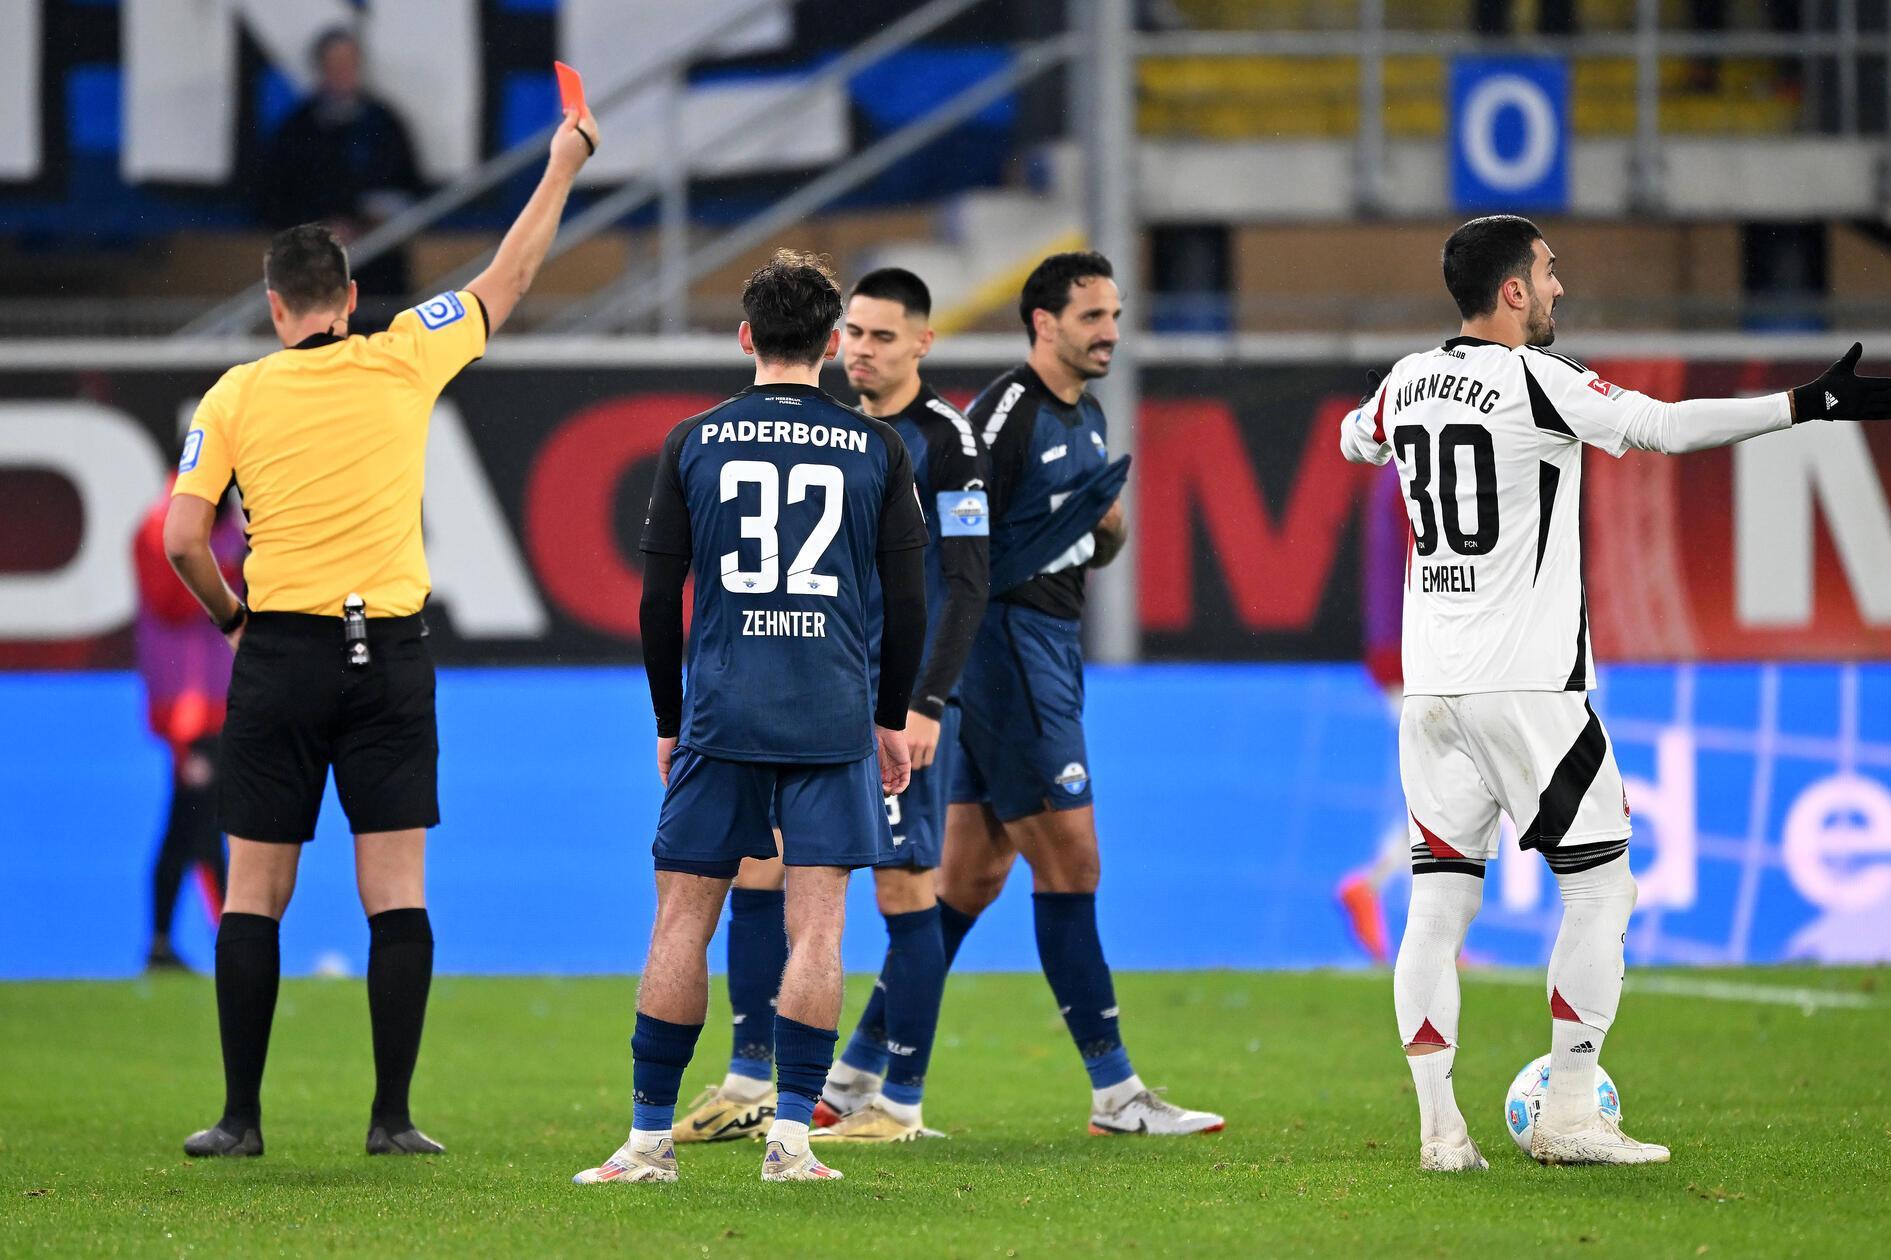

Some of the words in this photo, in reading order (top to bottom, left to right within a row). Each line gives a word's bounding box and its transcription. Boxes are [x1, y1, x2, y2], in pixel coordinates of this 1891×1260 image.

[1395, 373, 1501, 415] NÜRNBERG
[701, 421, 868, 453] PADERBORN
[1393, 423, 1500, 556] 30
[719, 460, 845, 597] 32
[1422, 565, 1476, 593] EMRELI
[742, 610, 826, 638] ZEHNTER
